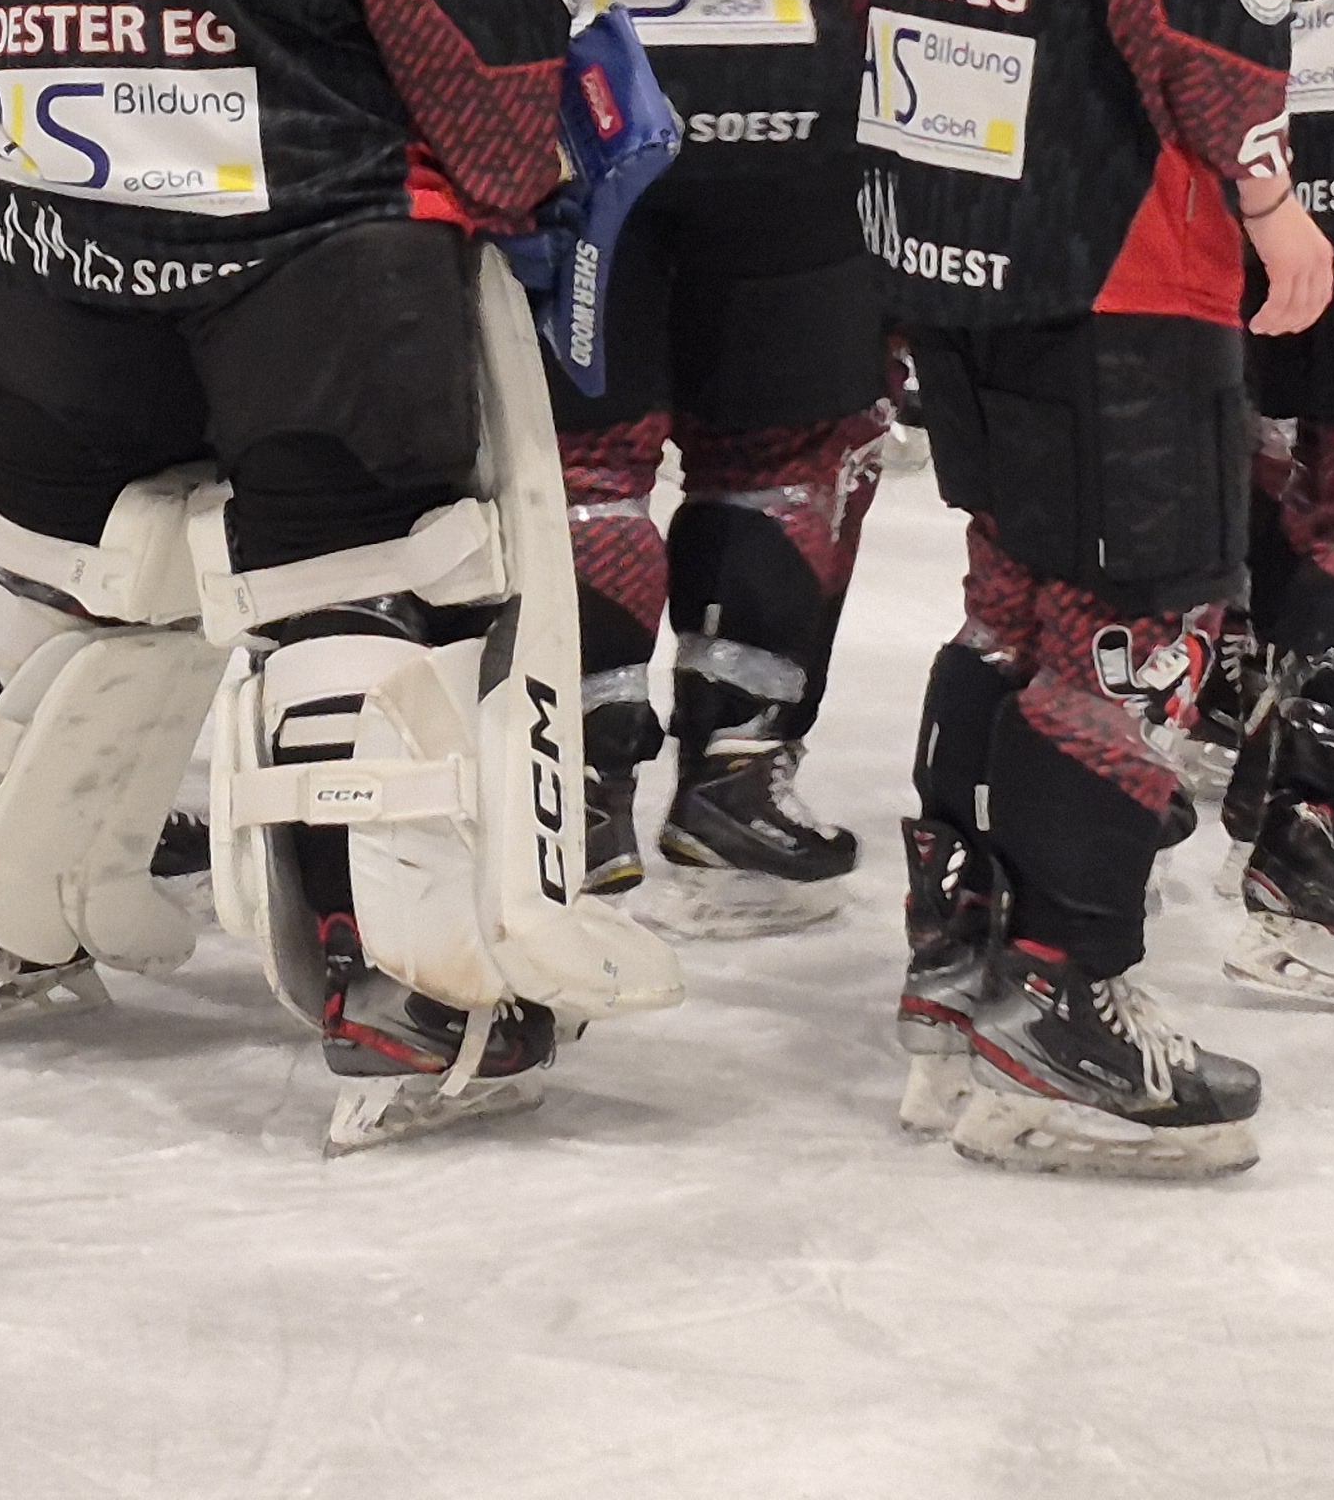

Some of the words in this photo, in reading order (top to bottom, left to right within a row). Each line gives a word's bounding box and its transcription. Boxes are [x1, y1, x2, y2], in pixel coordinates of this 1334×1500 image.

[163, 7, 238, 58] EG
[923, 33, 1022, 85] Bildung
[113, 82, 247, 122] Bildung
[689, 111, 819, 143] SOEST
[903, 237, 1011, 291] SOEST
[315, 787, 375, 804] CCM
[524, 675, 569, 906] CCM
